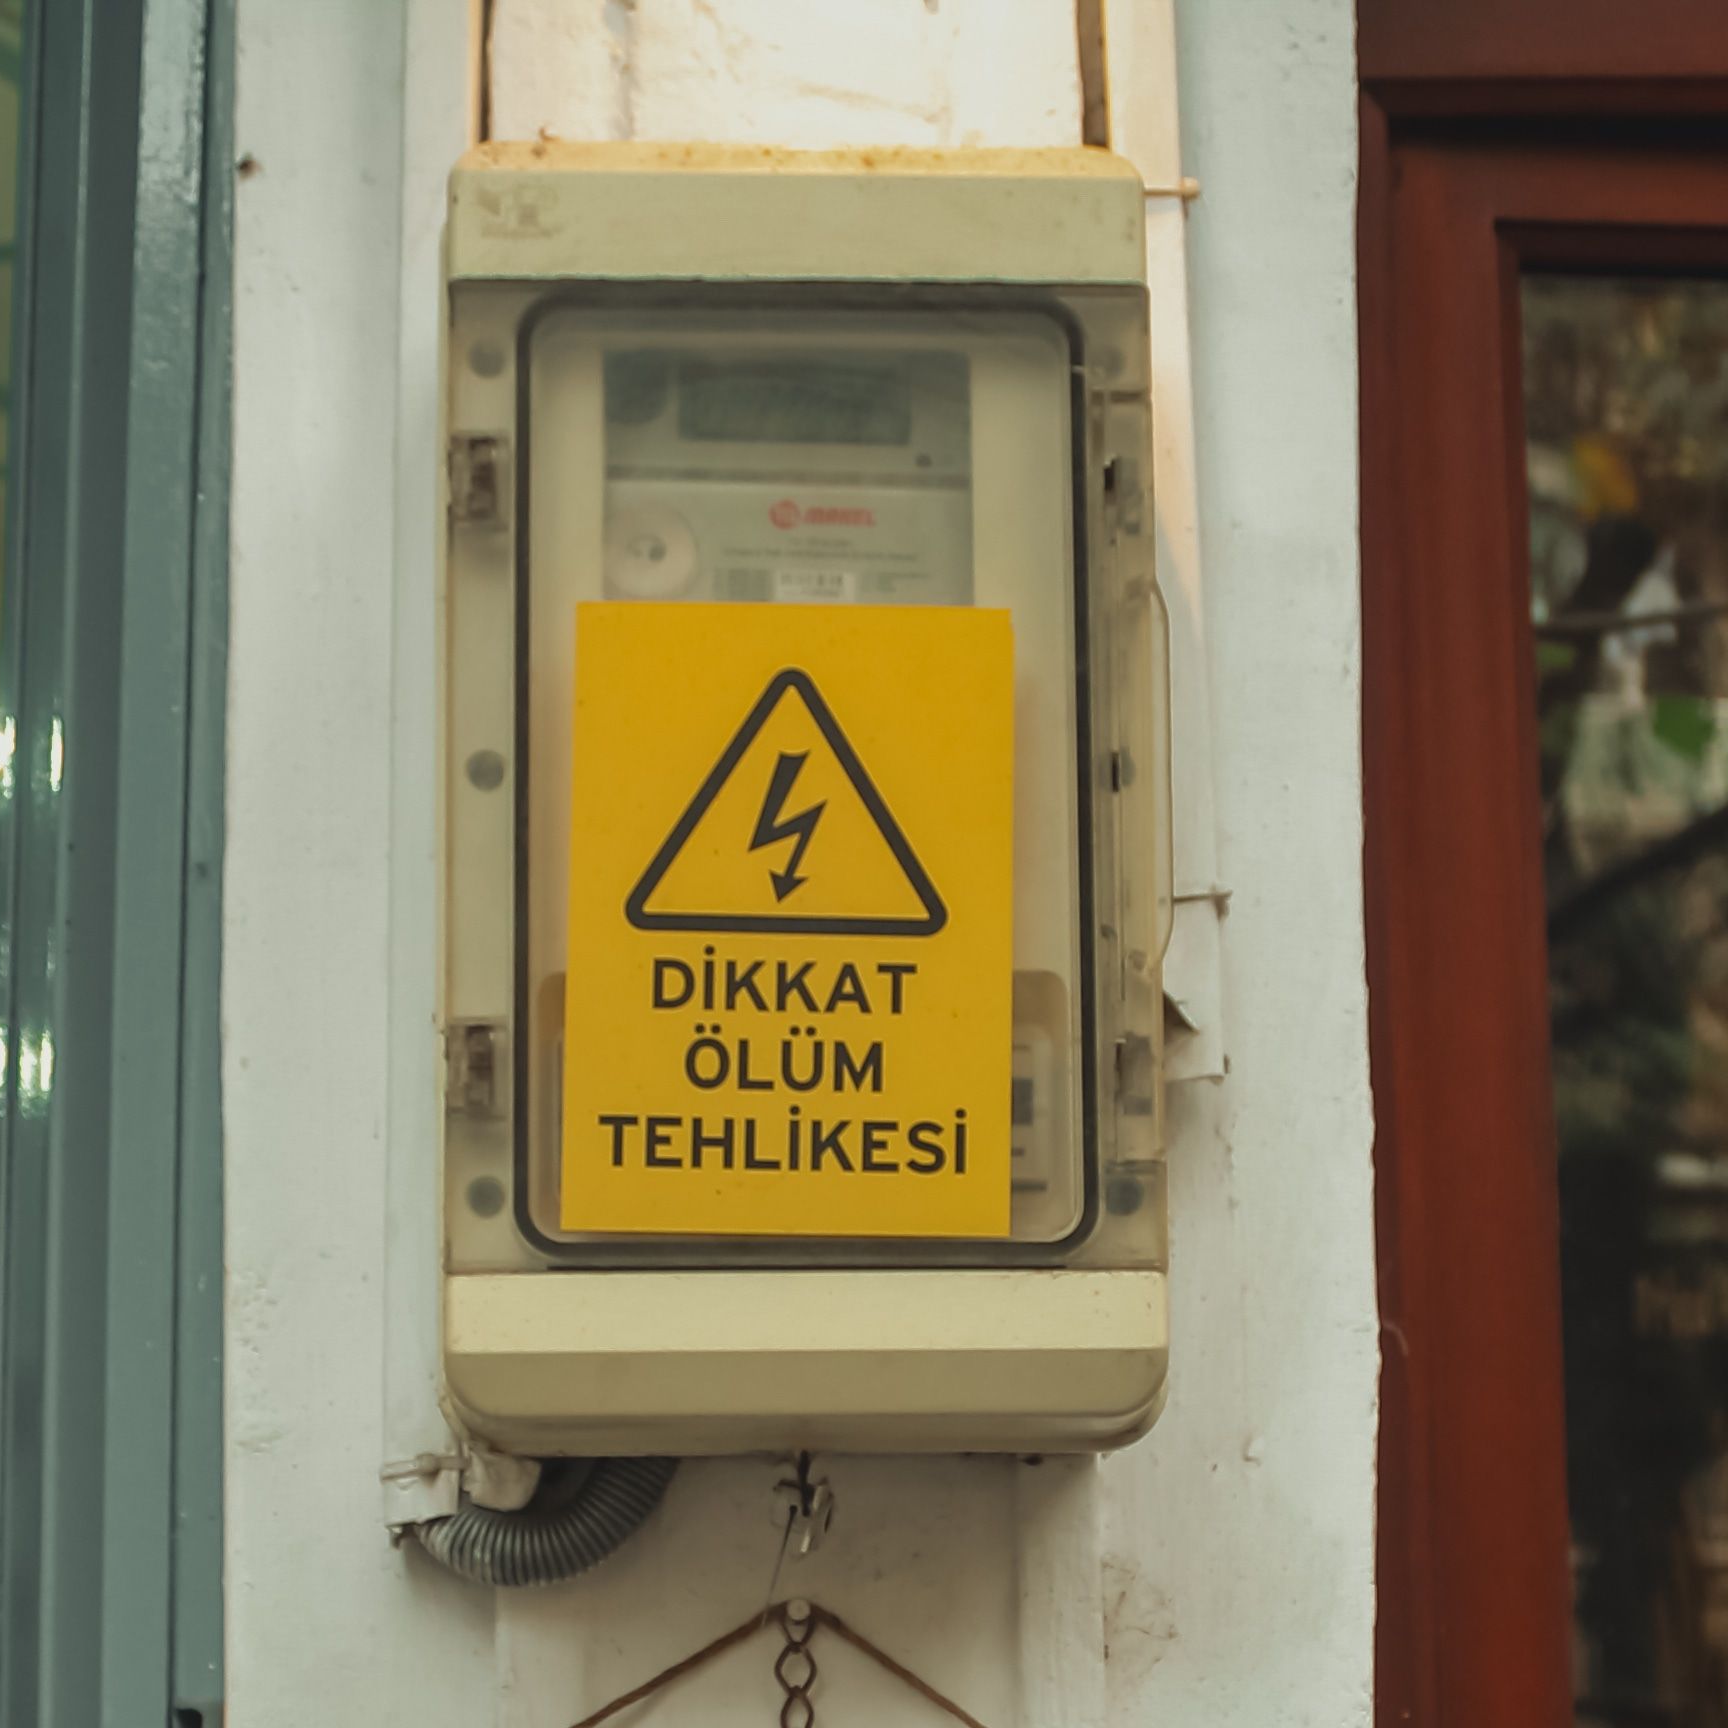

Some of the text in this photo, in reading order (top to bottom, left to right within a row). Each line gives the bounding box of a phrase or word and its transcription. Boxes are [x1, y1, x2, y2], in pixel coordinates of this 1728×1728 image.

[651, 945, 918, 1015] DİKKAT
[685, 1023, 884, 1093] ÖLÜM
[597, 1105, 968, 1175] TEHLİKESİ
